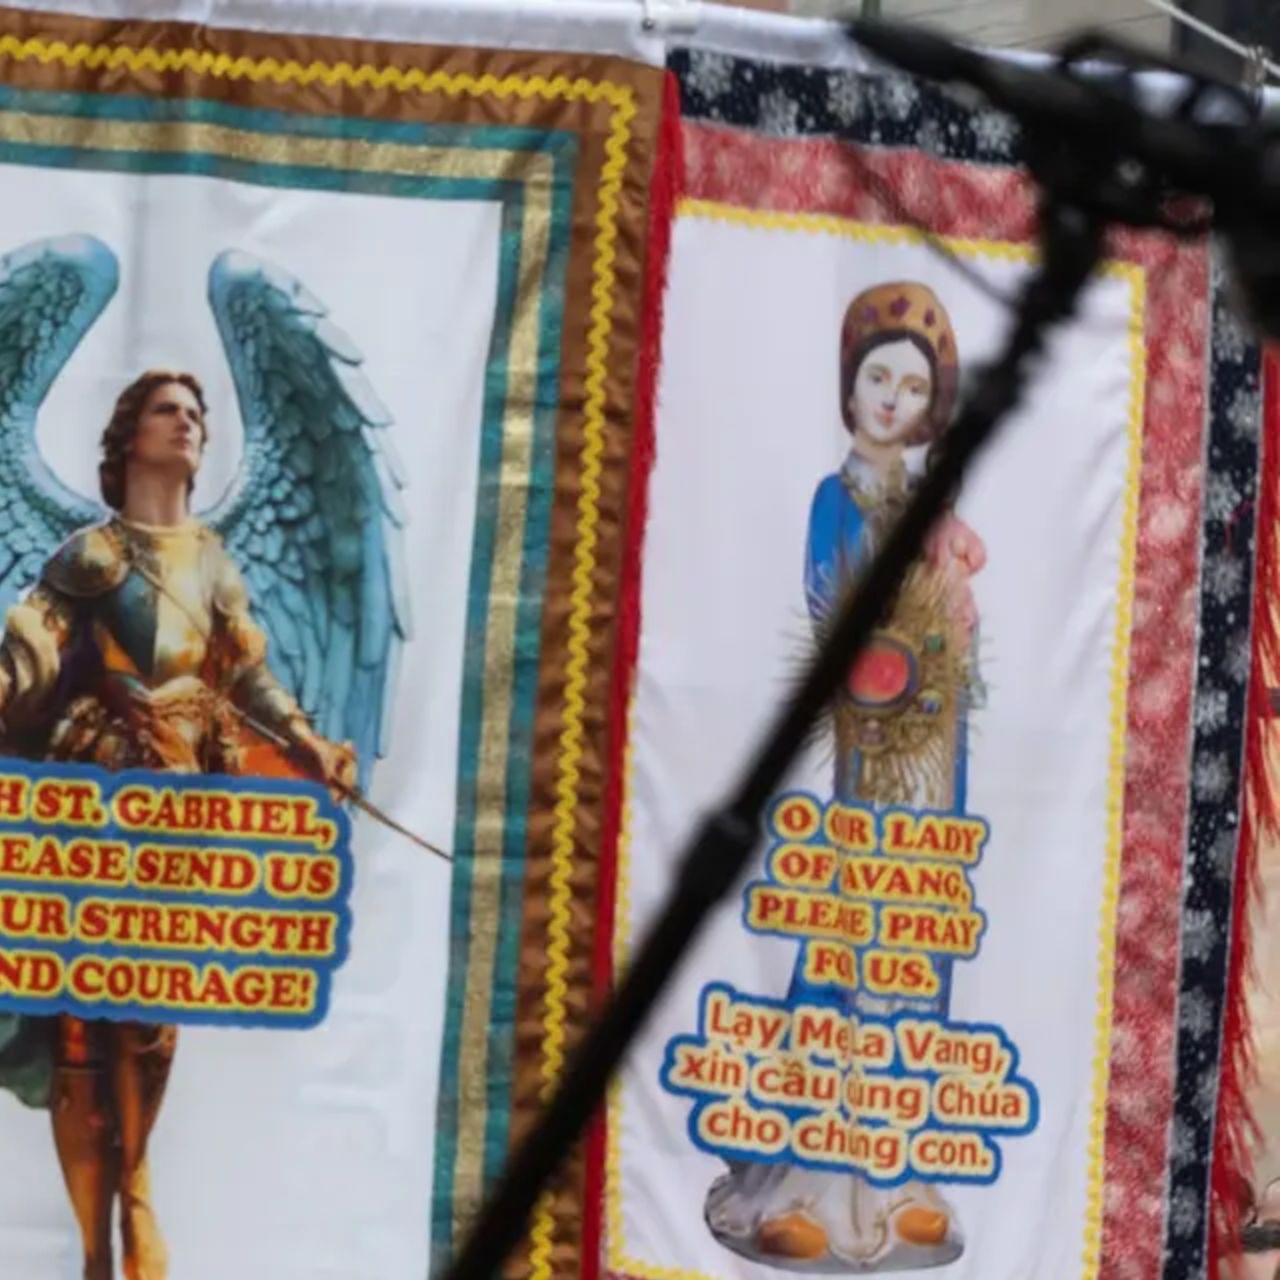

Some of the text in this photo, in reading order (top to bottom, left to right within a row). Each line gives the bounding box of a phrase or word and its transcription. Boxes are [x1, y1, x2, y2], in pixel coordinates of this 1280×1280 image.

[36, 782, 103, 823] ST.
[117, 791, 333, 846] GABRIEL,
[890, 819, 981, 857] LADY
[138, 850, 255, 889] SEND
[269, 859, 333, 895] US
[780, 851, 833, 882] OF
[81, 901, 332, 952] STRENGTH
[887, 913, 977, 948] PRAY
[72, 960, 312, 1009] COURAGE!
[870, 957, 934, 989] US.
[711, 1000, 783, 1049] Lạy
[903, 1028, 1005, 1075] Vang,
[680, 1050, 742, 1086] xin
[938, 1076, 1022, 1118] Chúa
[705, 1105, 782, 1144] cho
[916, 1139, 990, 1167] con.
